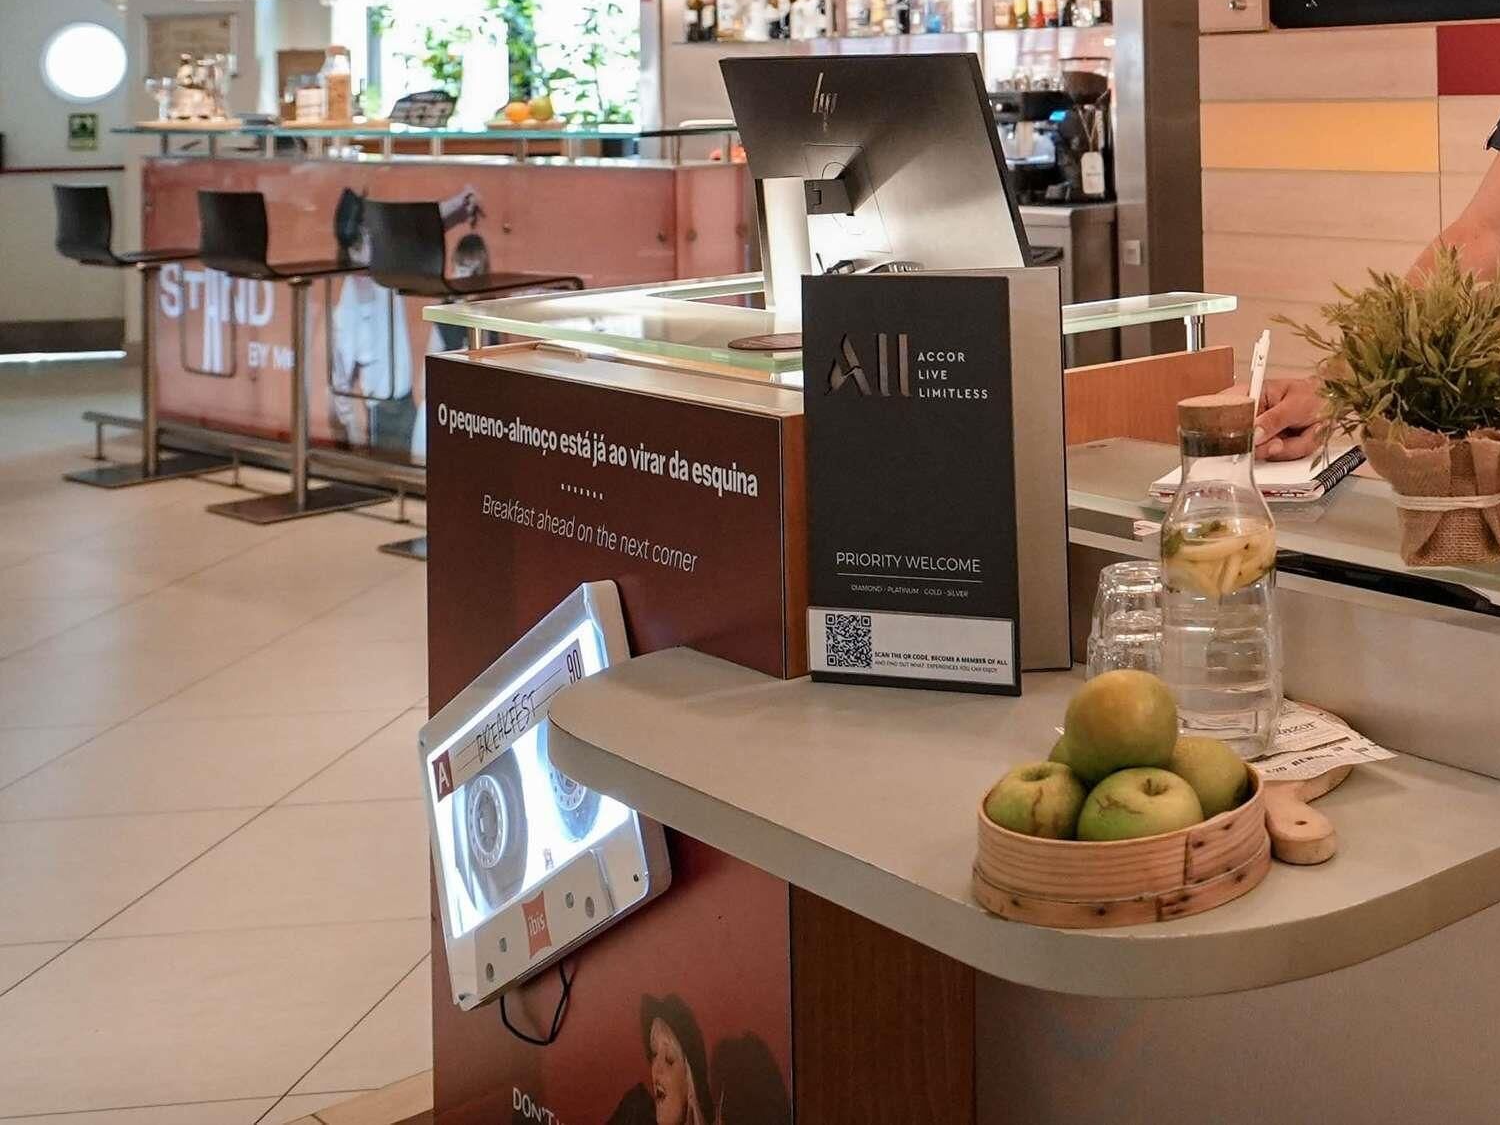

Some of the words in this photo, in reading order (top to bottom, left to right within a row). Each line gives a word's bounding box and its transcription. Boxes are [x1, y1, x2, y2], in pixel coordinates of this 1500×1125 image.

[917, 351, 966, 363] ACCOR
[918, 369, 948, 381] LIVE
[919, 387, 989, 400] LIMITLESS
[438, 402, 448, 426] O
[449, 407, 557, 456] pequeno-almoço
[559, 430, 592, 460] está
[592, 434, 606, 468] já
[608, 445, 628, 467] ao
[630, 443, 666, 476] virar
[668, 450, 690, 482] da
[692, 462, 758, 498] esquina
[482, 493, 536, 528] Breakfast
[536, 509, 576, 539] ahead
[577, 522, 593, 543] on
[597, 524, 617, 551] the
[619, 534, 650, 560] next
[652, 543, 699, 573] corner
[836, 551, 902, 569] PRIORITY
[905, 555, 981, 573] WELCOME
[851, 584, 883, 593] DIAMOND
[887, 586, 919, 595] PLATINUM
[946, 589, 969, 598] SILVER
[566, 649, 582, 685] 90
[874, 651, 891, 659] SCAN
[931, 655, 955, 663] BECOME
[961, 656, 986, 665] MEMBER
[437, 761, 451, 794] A
[527, 911, 546, 937] ibis
[512, 1086, 555, 1125] DON'T
